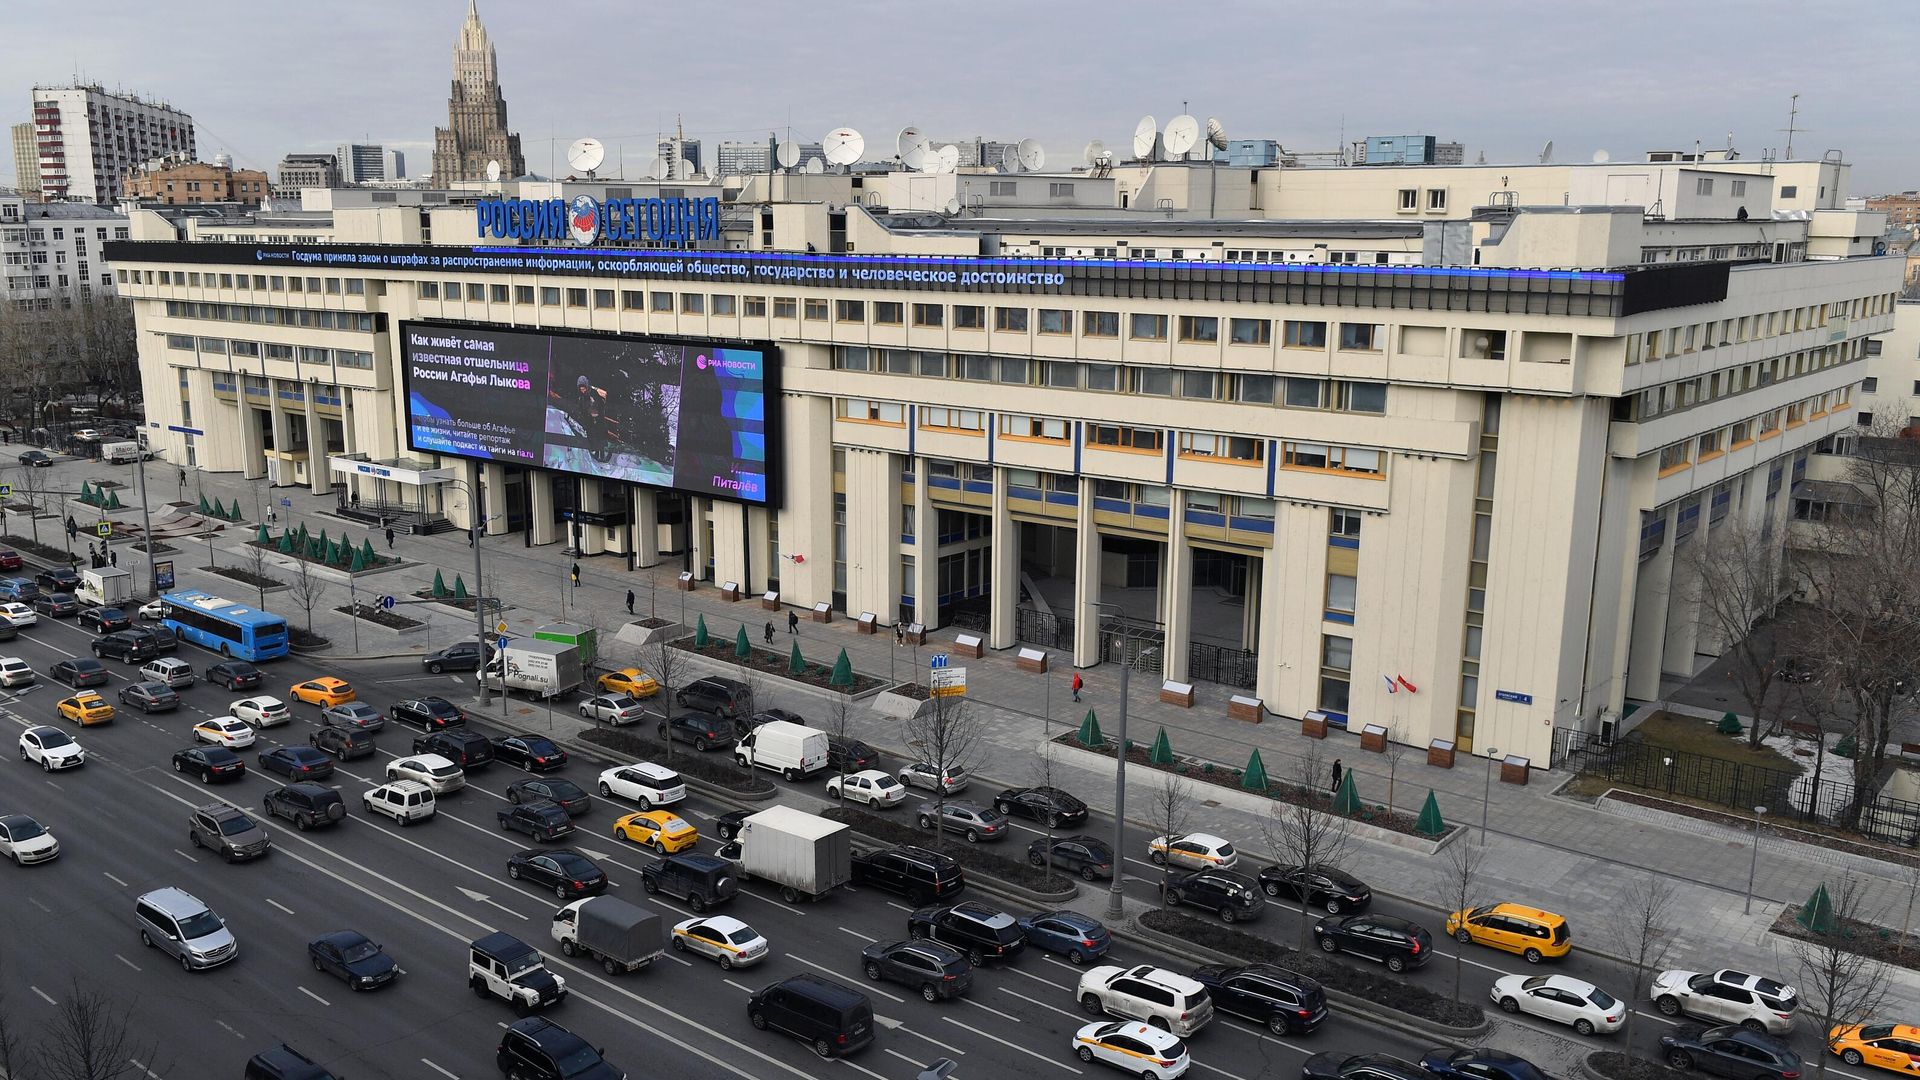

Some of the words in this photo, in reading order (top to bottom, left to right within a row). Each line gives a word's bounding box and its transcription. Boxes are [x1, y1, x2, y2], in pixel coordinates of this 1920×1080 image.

[476, 198, 567, 240] РОССИЯ
[604, 196, 719, 248] СЕГОДНЯ
[292, 250, 322, 264] Госдума
[323, 253, 356, 264] приняла
[358, 254, 381, 263] закон
[383, 256, 389, 264] о
[391, 253, 428, 266] штрафах
[430, 256, 440, 265] за
[442, 255, 523, 269] распространение
[525, 256, 595, 272] информации,
[597, 259, 684, 274] оскорбляющей
[687, 260, 750, 277] общество,
[754, 264, 835, 280] государство
[839, 269, 848, 279] и
[852, 270, 957, 283] человеческое
[961, 271, 1065, 285] достоинство
[411, 333, 429, 347] Как
[430, 336, 462, 349] живёт
[464, 339, 495, 352] самая
[412, 352, 462, 366] известная
[464, 358, 529, 373] отшельница
[708, 359, 722, 368] РИА
[723, 360, 756, 371] НОВОСТИ
[413, 367, 448, 381] России
[450, 371, 487, 386] Агафья
[489, 375, 531, 390] Лыкова
[457, 418, 481, 430] больше
[482, 422, 491, 431] об
[452, 430, 477, 440] читайте
[479, 433, 511, 444] репортаж
[423, 436, 452, 445] слушайте
[453, 440, 478, 450] подкаст
[488, 444, 506, 455] тайги
[507, 448, 516, 456] на
[517, 448, 534, 459] ria.ru
[712, 475, 758, 493] Питалёв
[513, 670, 548, 683] Pognali.su
